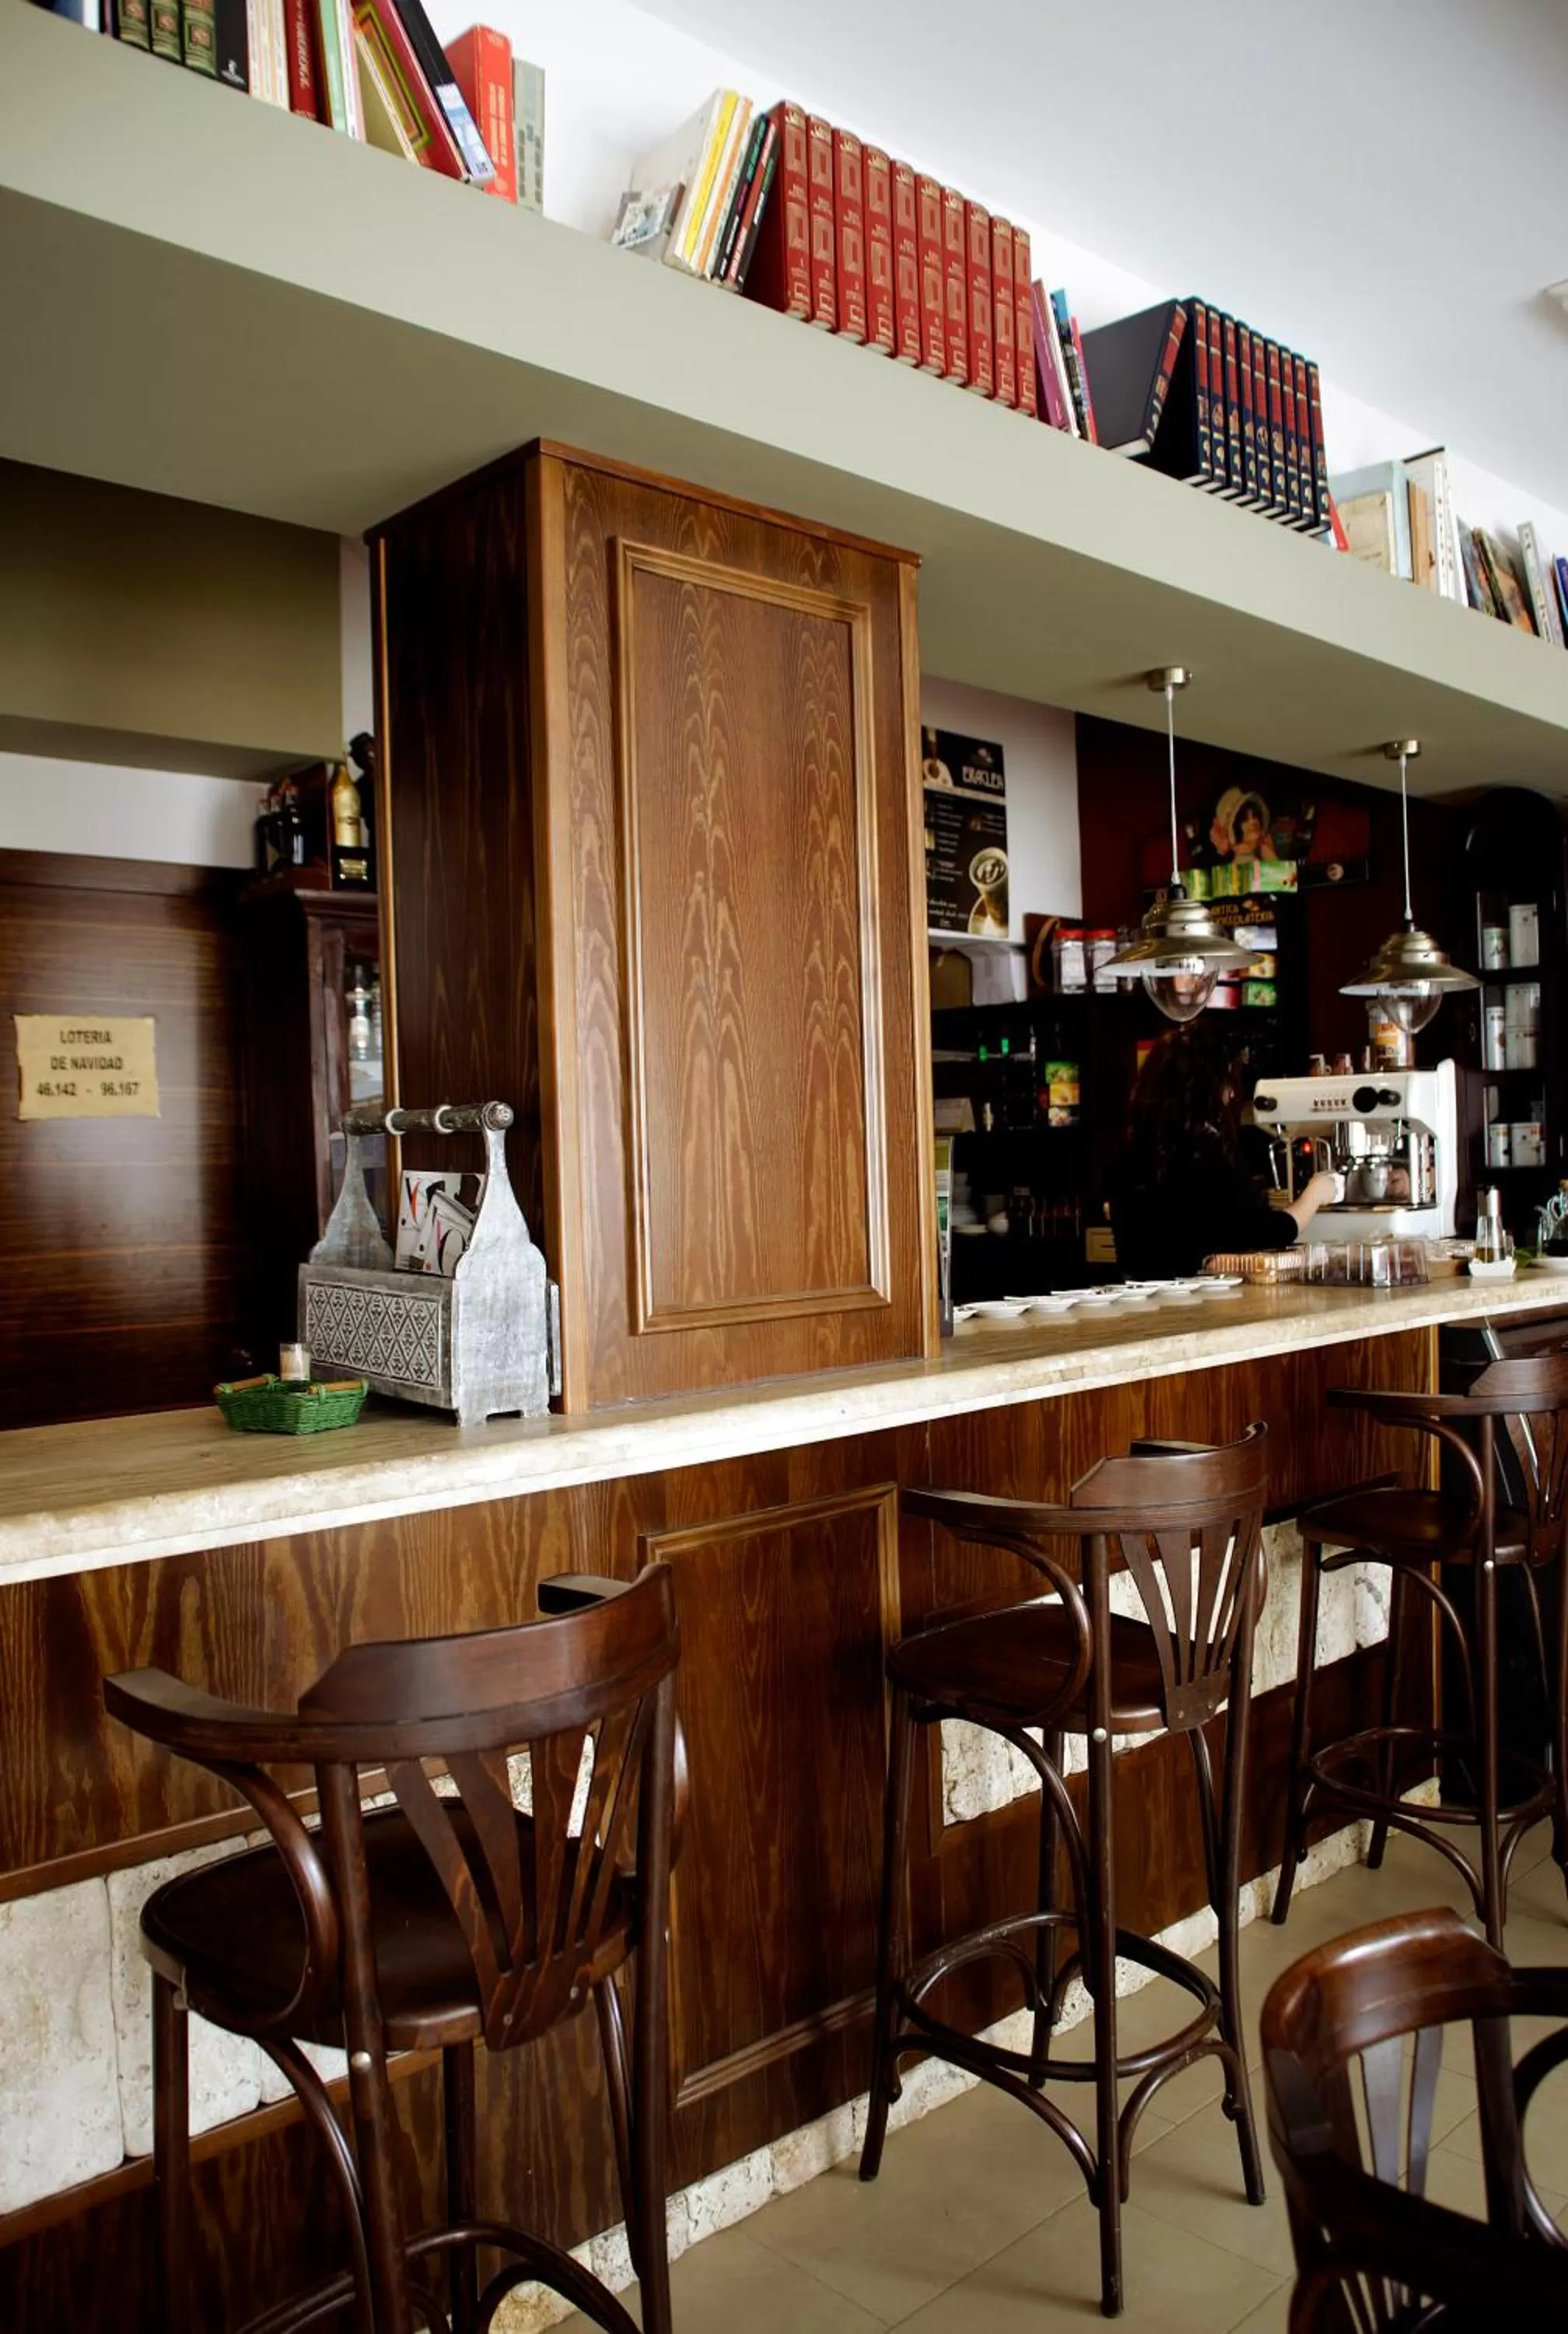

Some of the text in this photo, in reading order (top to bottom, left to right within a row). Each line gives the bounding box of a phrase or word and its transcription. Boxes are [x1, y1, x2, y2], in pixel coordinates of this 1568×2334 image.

[59, 1029, 112, 1044] LOTERIA
[50, 1056, 124, 1071] DE NAVIDAD
[37, 1082, 77, 1097] 46.142
